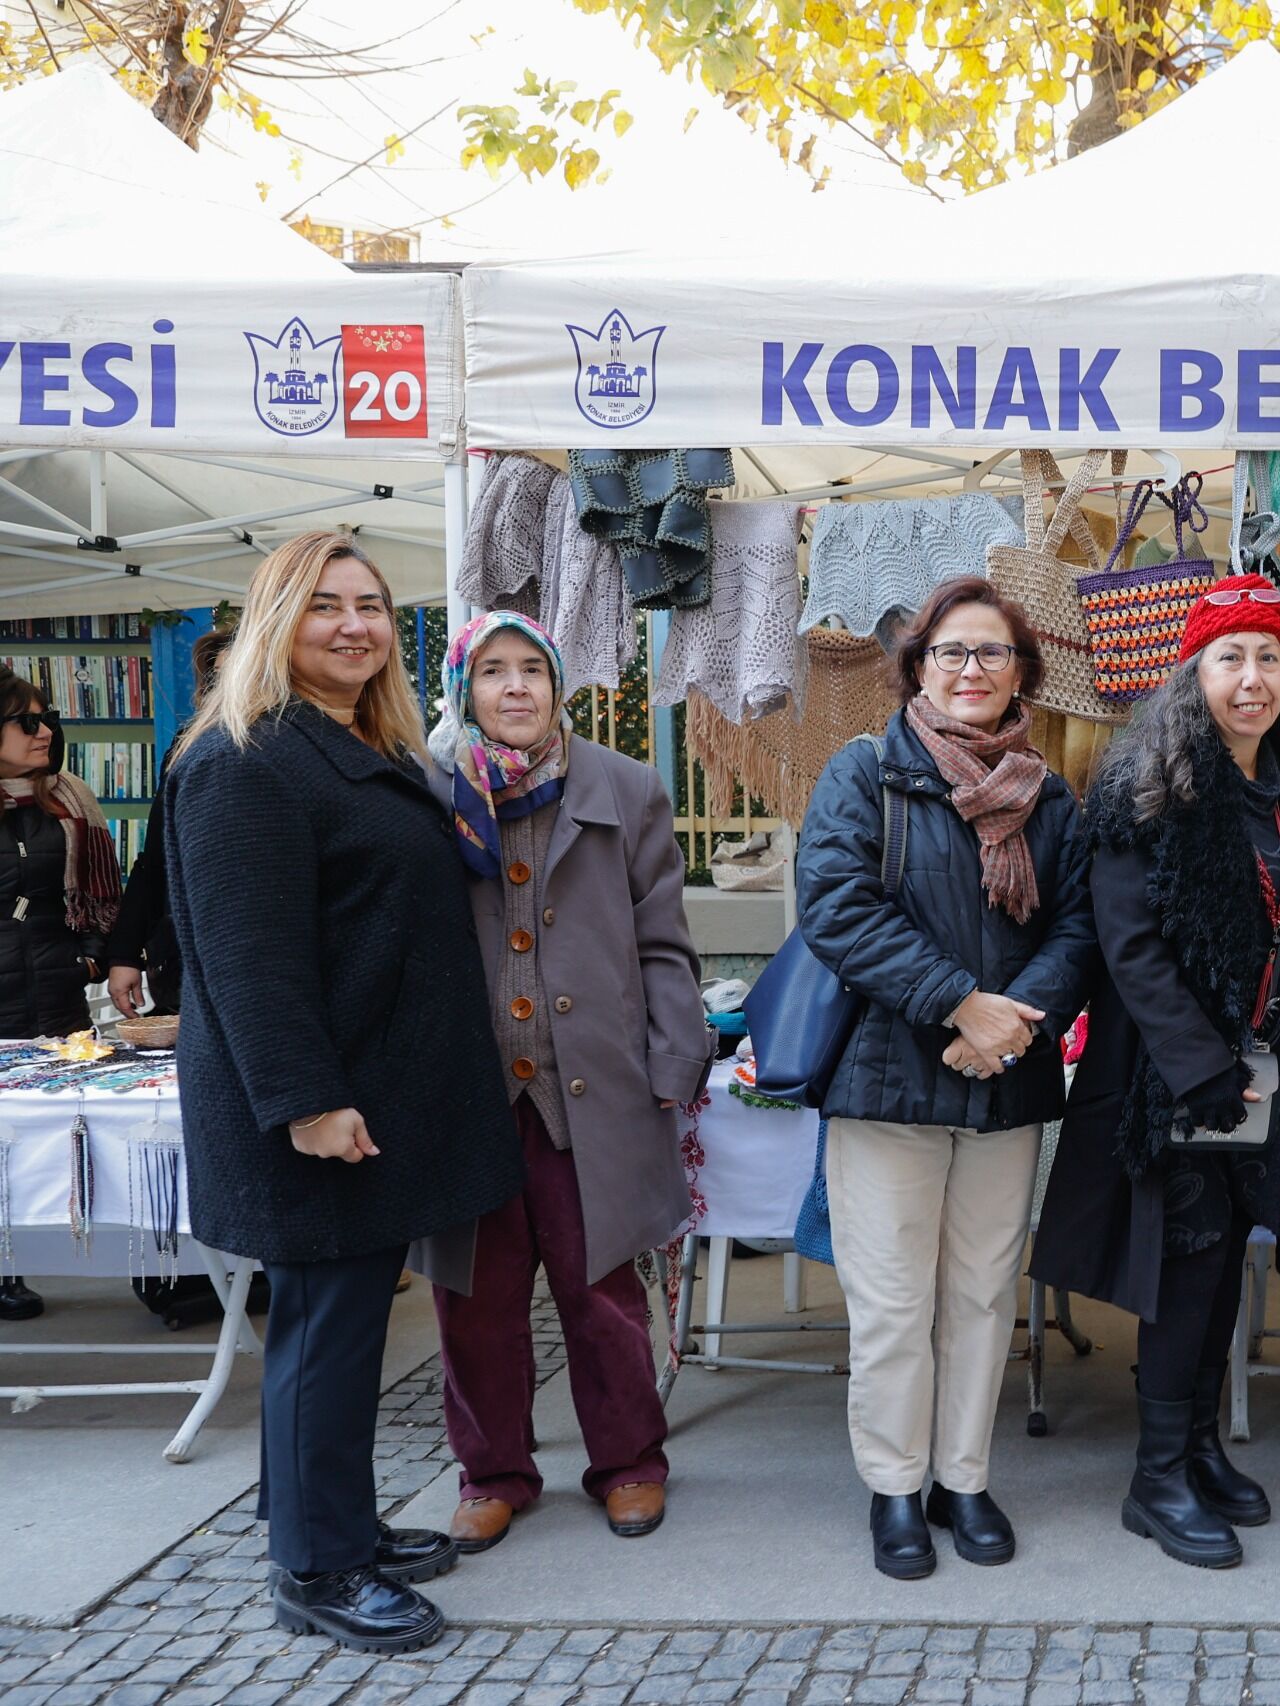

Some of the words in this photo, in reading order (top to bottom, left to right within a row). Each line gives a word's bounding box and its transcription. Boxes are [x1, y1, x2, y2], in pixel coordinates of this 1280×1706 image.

[0, 319, 177, 428] ESİ
[348, 370, 422, 422] 20
[762, 342, 1121, 432] KONAK
[266, 411, 289, 429] KONAK
[290, 410, 328, 430] BELEDİYESİ
[586, 403, 608, 421] KONAK
[608, 402, 646, 423] BELEDİYESİ
